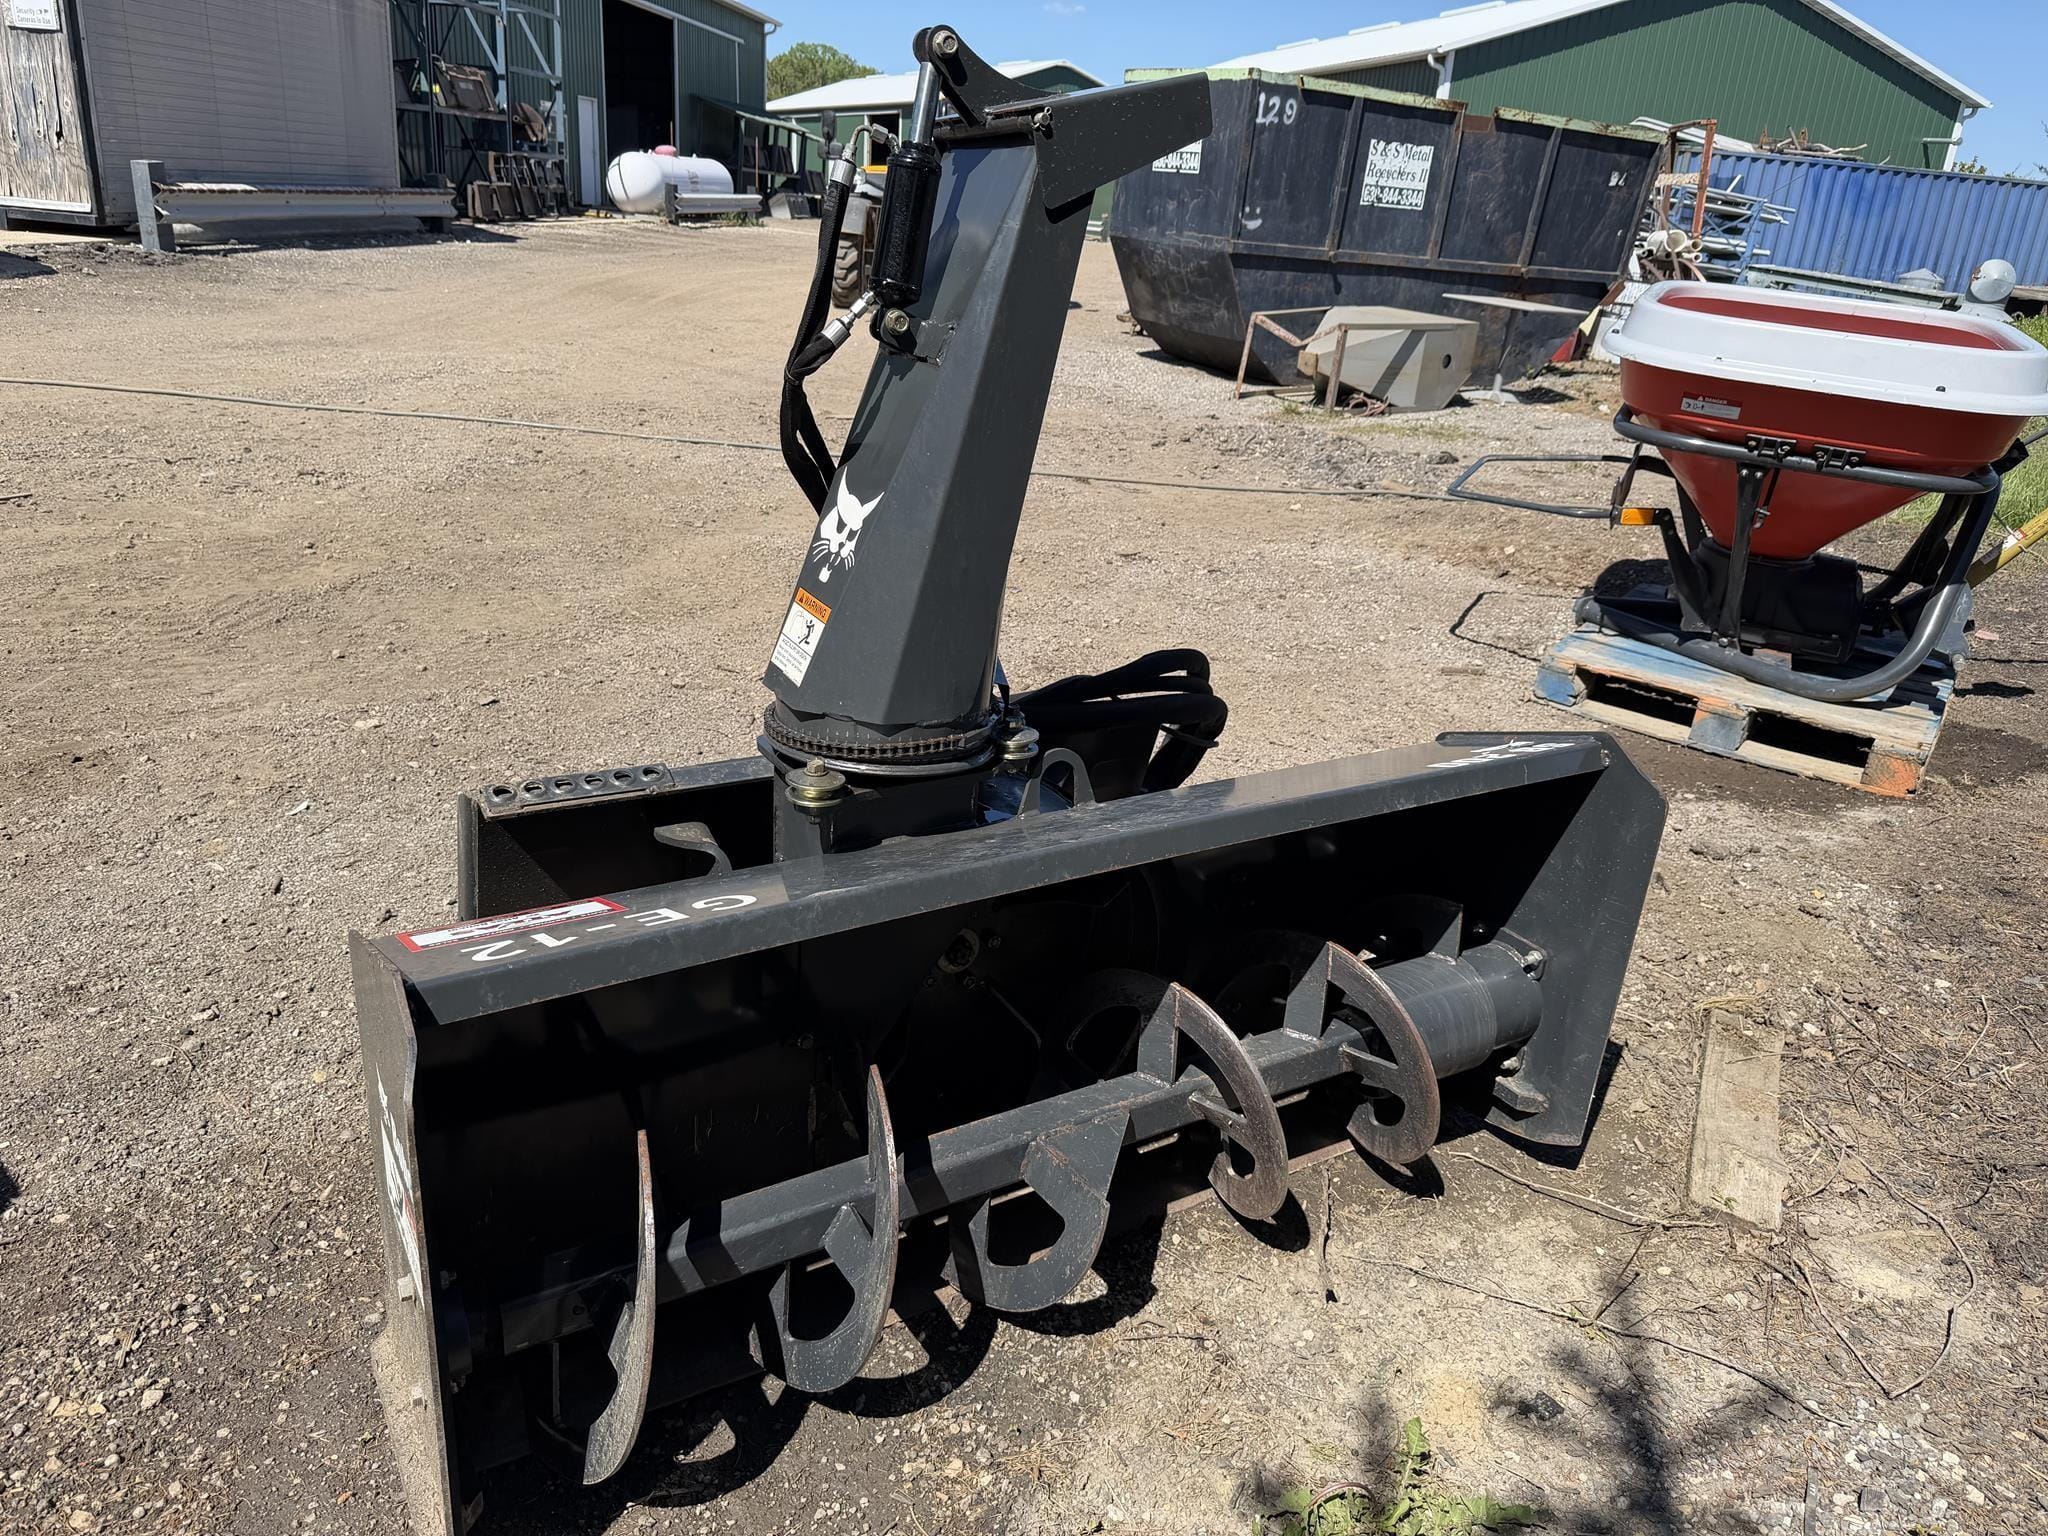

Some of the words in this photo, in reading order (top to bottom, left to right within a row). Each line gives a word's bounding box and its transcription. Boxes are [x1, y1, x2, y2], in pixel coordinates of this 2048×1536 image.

[1371, 141, 1377, 156] S
[1380, 144, 1391, 157] &
[1392, 143, 1401, 158] S
[1403, 144, 1432, 161] Metal
[1367, 160, 1416, 182] Recyclers
[804, 594, 827, 618] WARNING
